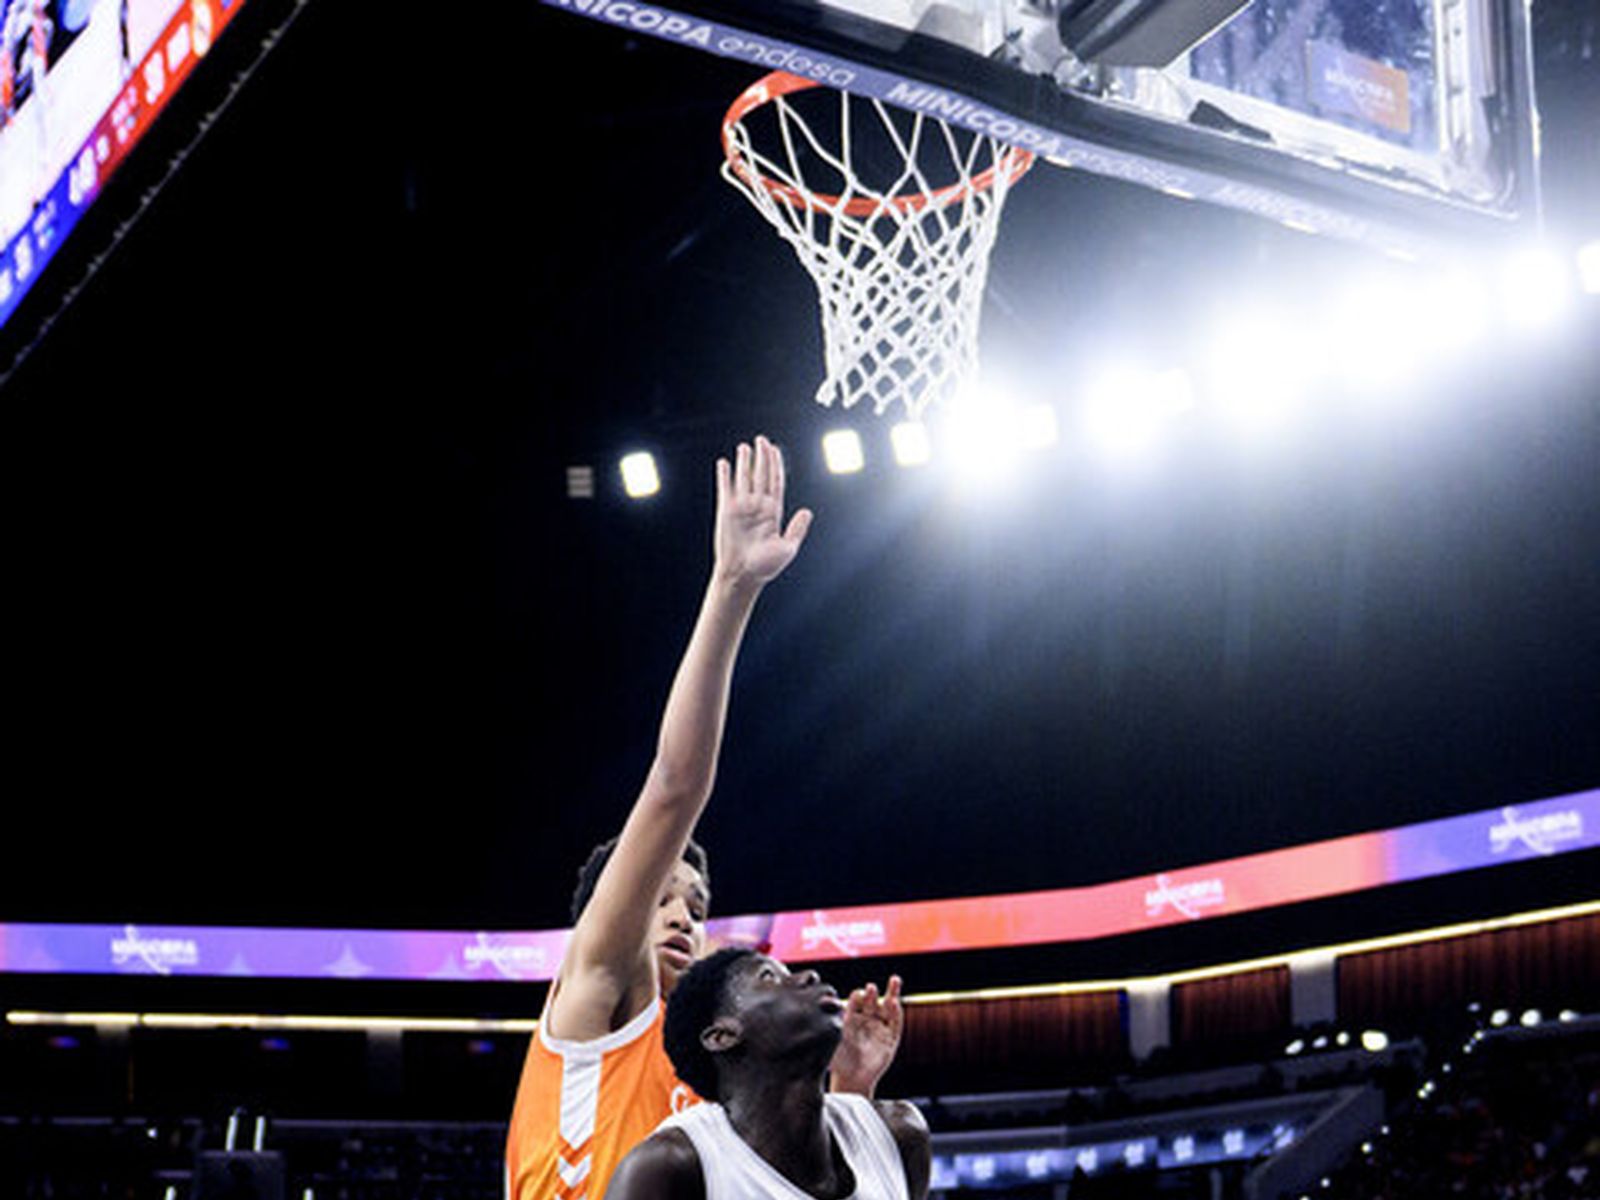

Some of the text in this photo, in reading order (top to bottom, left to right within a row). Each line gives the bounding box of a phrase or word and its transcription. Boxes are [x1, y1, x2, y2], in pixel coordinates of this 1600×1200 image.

[559, 0, 856, 87] NICOPA endesa
[887, 83, 1061, 155] MINICOPA
